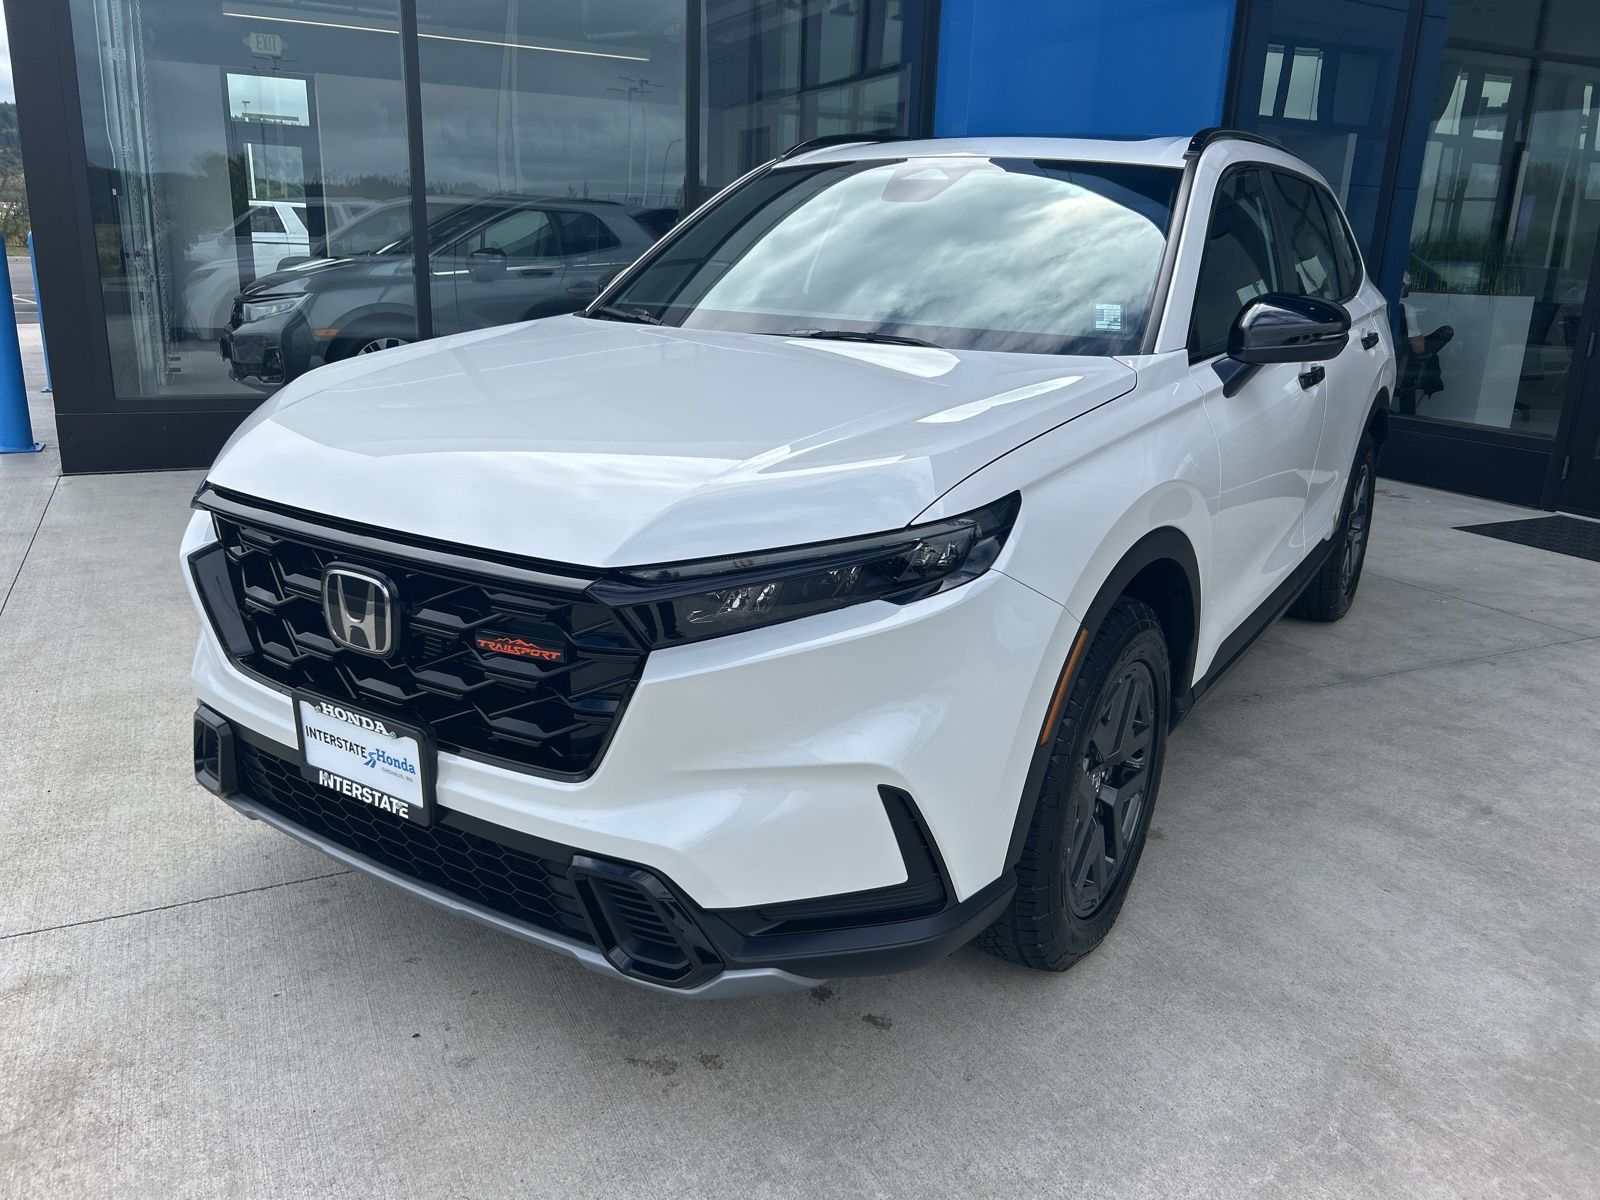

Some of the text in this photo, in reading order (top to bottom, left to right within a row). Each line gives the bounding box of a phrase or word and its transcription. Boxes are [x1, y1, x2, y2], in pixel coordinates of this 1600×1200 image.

[256, 35, 277, 52] EXIT
[477, 639, 560, 660] TRAILSPORT
[319, 702, 390, 737] HONDA
[305, 725, 416, 775] INTERSTATE Honda
[319, 770, 409, 819] INTERSTATE
